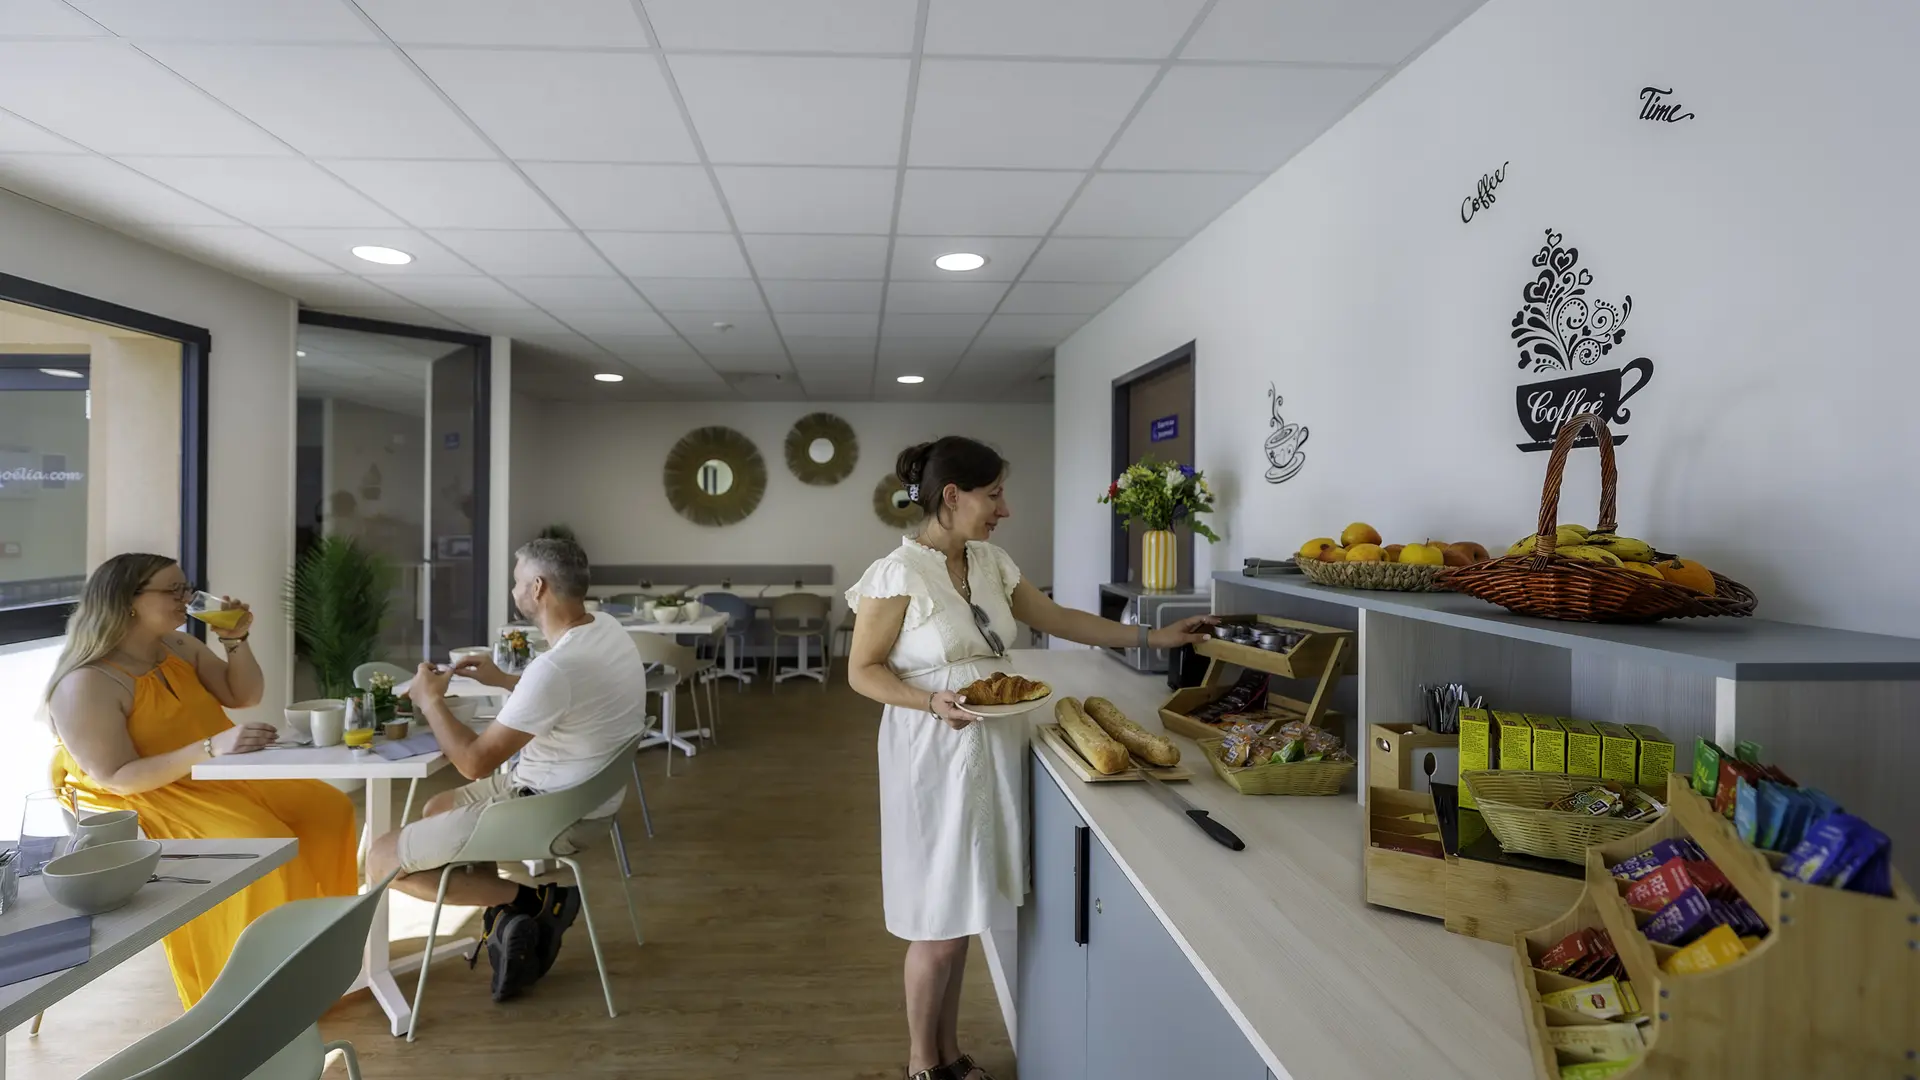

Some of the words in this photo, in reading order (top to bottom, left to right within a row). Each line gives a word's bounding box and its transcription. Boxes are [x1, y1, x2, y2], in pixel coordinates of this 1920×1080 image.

[1639, 86, 1695, 123] Time
[1460, 160, 1510, 224] Coffee
[1527, 387, 1604, 436] Coffee
